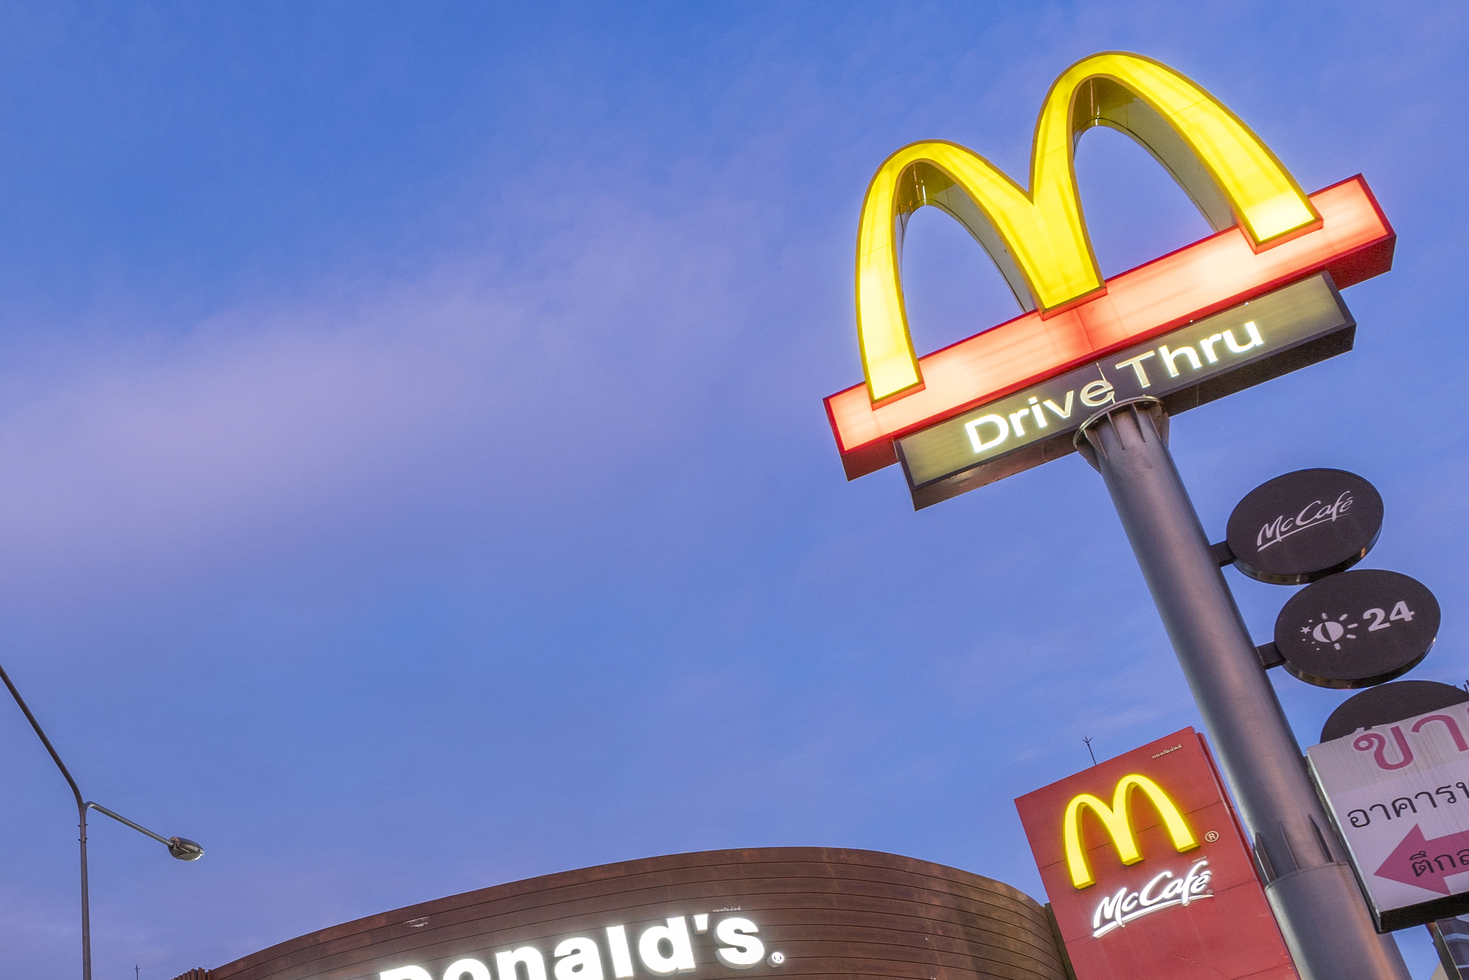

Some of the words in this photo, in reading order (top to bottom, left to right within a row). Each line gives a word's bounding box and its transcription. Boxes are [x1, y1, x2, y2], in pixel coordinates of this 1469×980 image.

[964, 378, 1116, 454] Drive
[1114, 320, 1265, 391] Thru
[1256, 489, 1354, 548] McCafé
[1362, 600, 1416, 632] 24
[1353, 713, 1469, 771] ขา
[1092, 859, 1214, 932] McCafé
